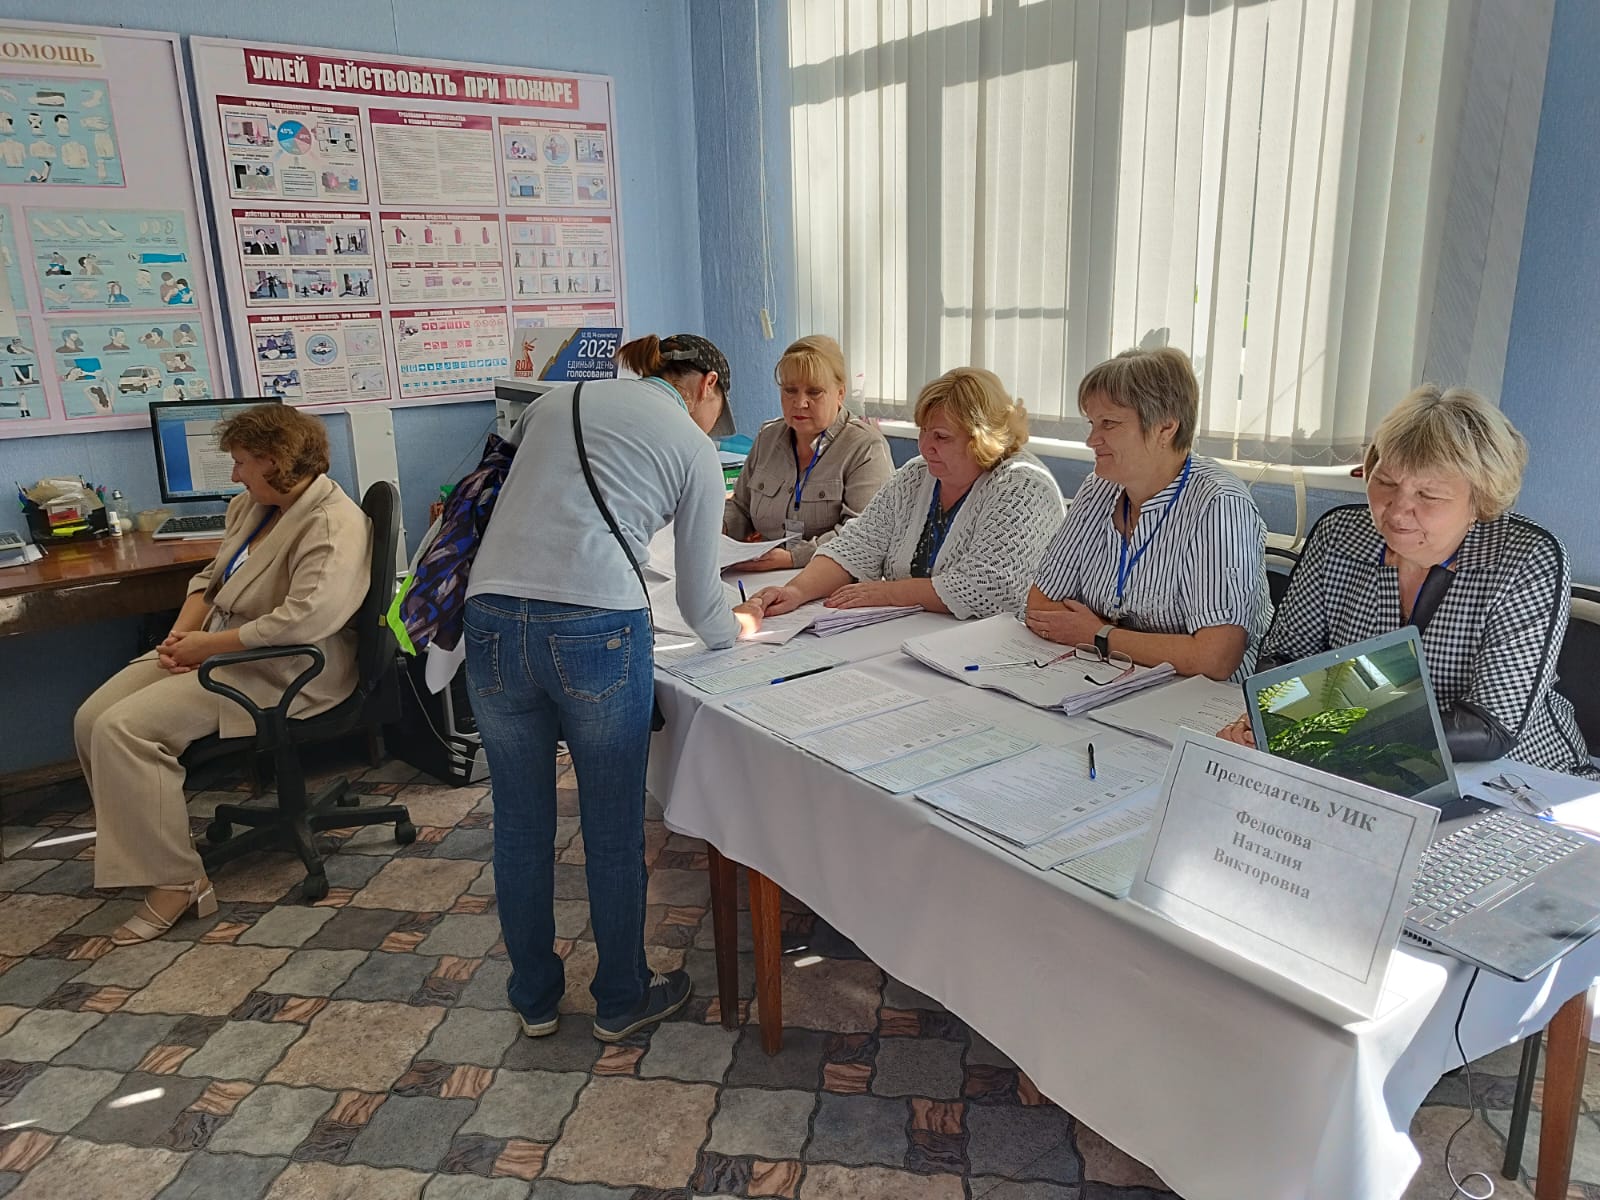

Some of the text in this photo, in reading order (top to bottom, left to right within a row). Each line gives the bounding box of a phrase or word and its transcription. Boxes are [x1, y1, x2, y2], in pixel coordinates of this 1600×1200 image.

[0, 41, 95, 65] ОМОЩЬ
[249, 55, 573, 104] УМЕЙ ДЕЙСТВОВАТЬ ПРИ ПОЖАРЕ
[567, 360, 614, 370] ЕДИНЫЙ ДЕНЬ
[577, 339, 616, 358] 2025
[1204, 759, 1320, 813] Председатель
[1327, 802, 1377, 832] УИК
[1236, 809, 1312, 850] Федосова
[1232, 831, 1303, 871] Наталия
[1213, 847, 1310, 899] Викторовна
